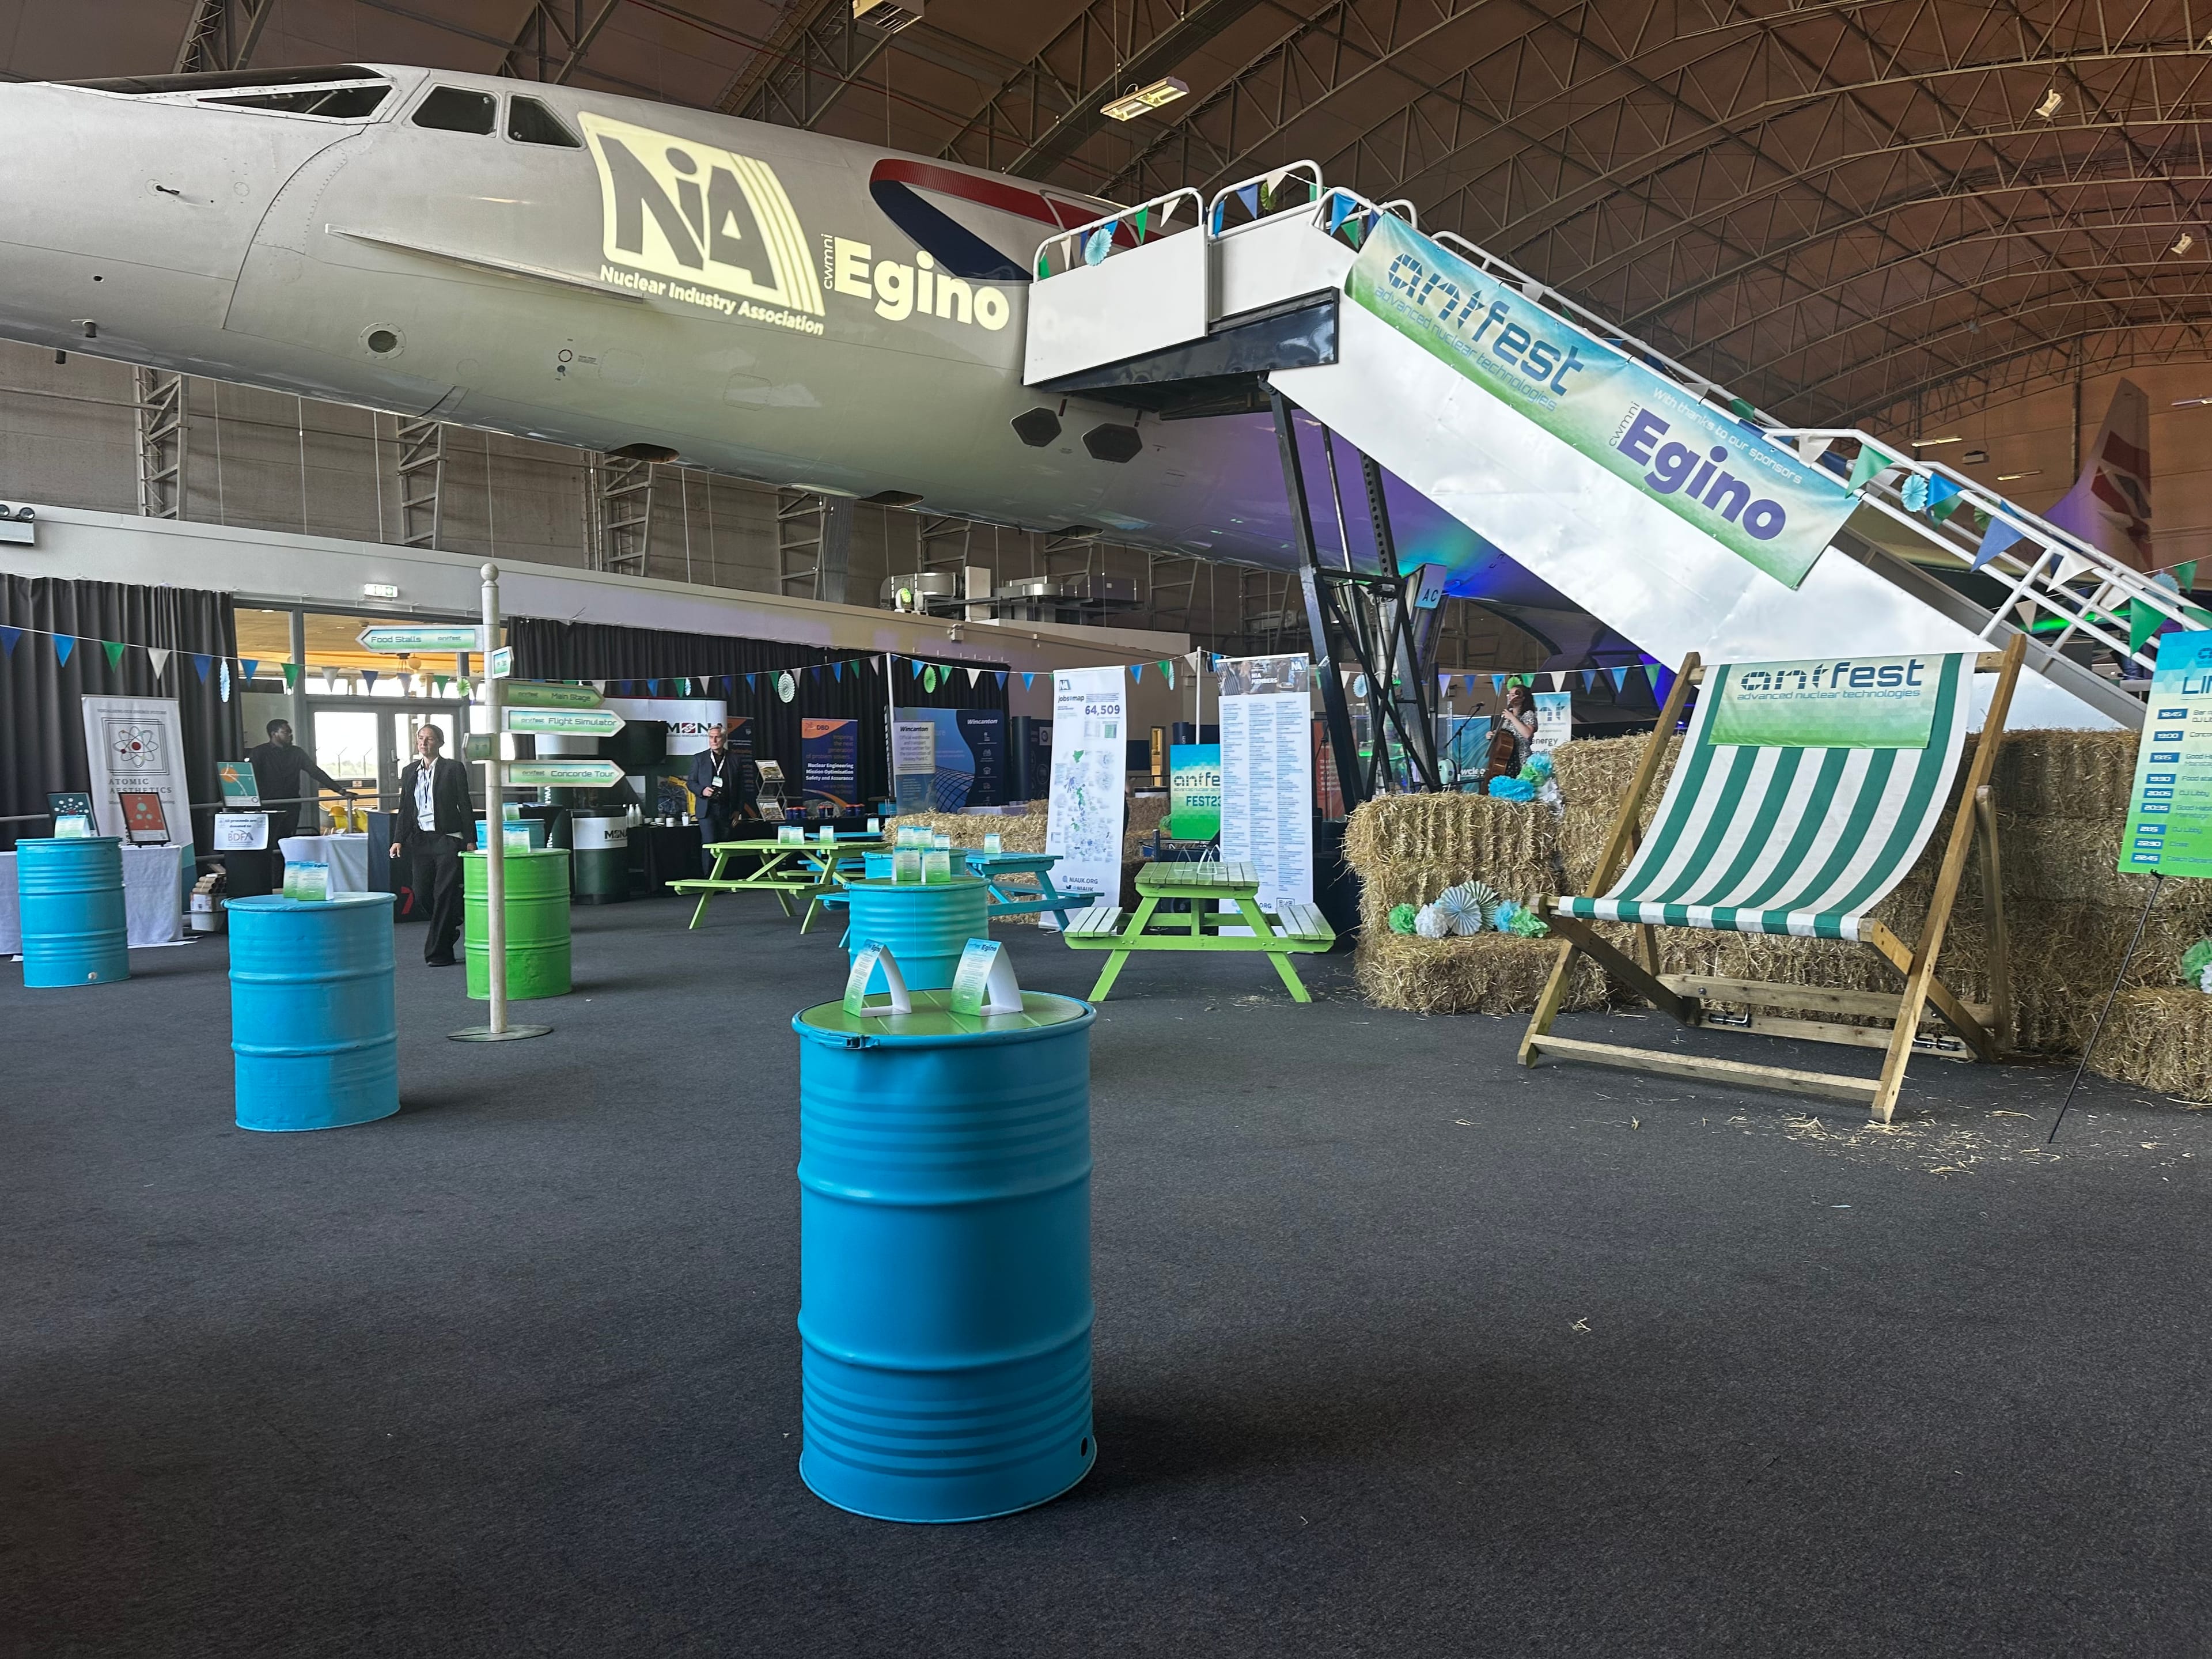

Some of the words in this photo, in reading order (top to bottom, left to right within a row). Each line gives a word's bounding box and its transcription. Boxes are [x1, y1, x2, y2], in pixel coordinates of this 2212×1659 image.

[821, 233, 834, 290] cwmni
[835, 237, 1009, 331] Egino
[600, 264, 666, 296] Nuclear
[669, 282, 737, 316] Industry
[738, 300, 825, 336] Association
[1388, 253, 1584, 396] antfest
[1374, 286, 1435, 332] advanced
[1431, 324, 1479, 359] nuclear
[1475, 353, 1558, 412] technologies
[1608, 400, 1641, 447] cwmni
[1653, 387, 1677, 408] With
[1676, 403, 1715, 431] thanks
[1715, 425, 1728, 439] to
[1730, 434, 1749, 450] our
[1748, 448, 1802, 484] sponsors
[1616, 408, 1786, 540] Egino
[570, 694, 591, 702] Stage
[1737, 691, 1794, 700] advanced
[1795, 690, 1841, 699] nuclear
[1843, 688, 1921, 700] technologies
[1740, 659, 1925, 690] antfest
[548, 718, 573, 726] Flight
[574, 718, 617, 726] Simulator
[1085, 704, 1120, 716] 64,509
[1532, 738, 1558, 747] energy
[228, 832, 253, 842] BDFA
